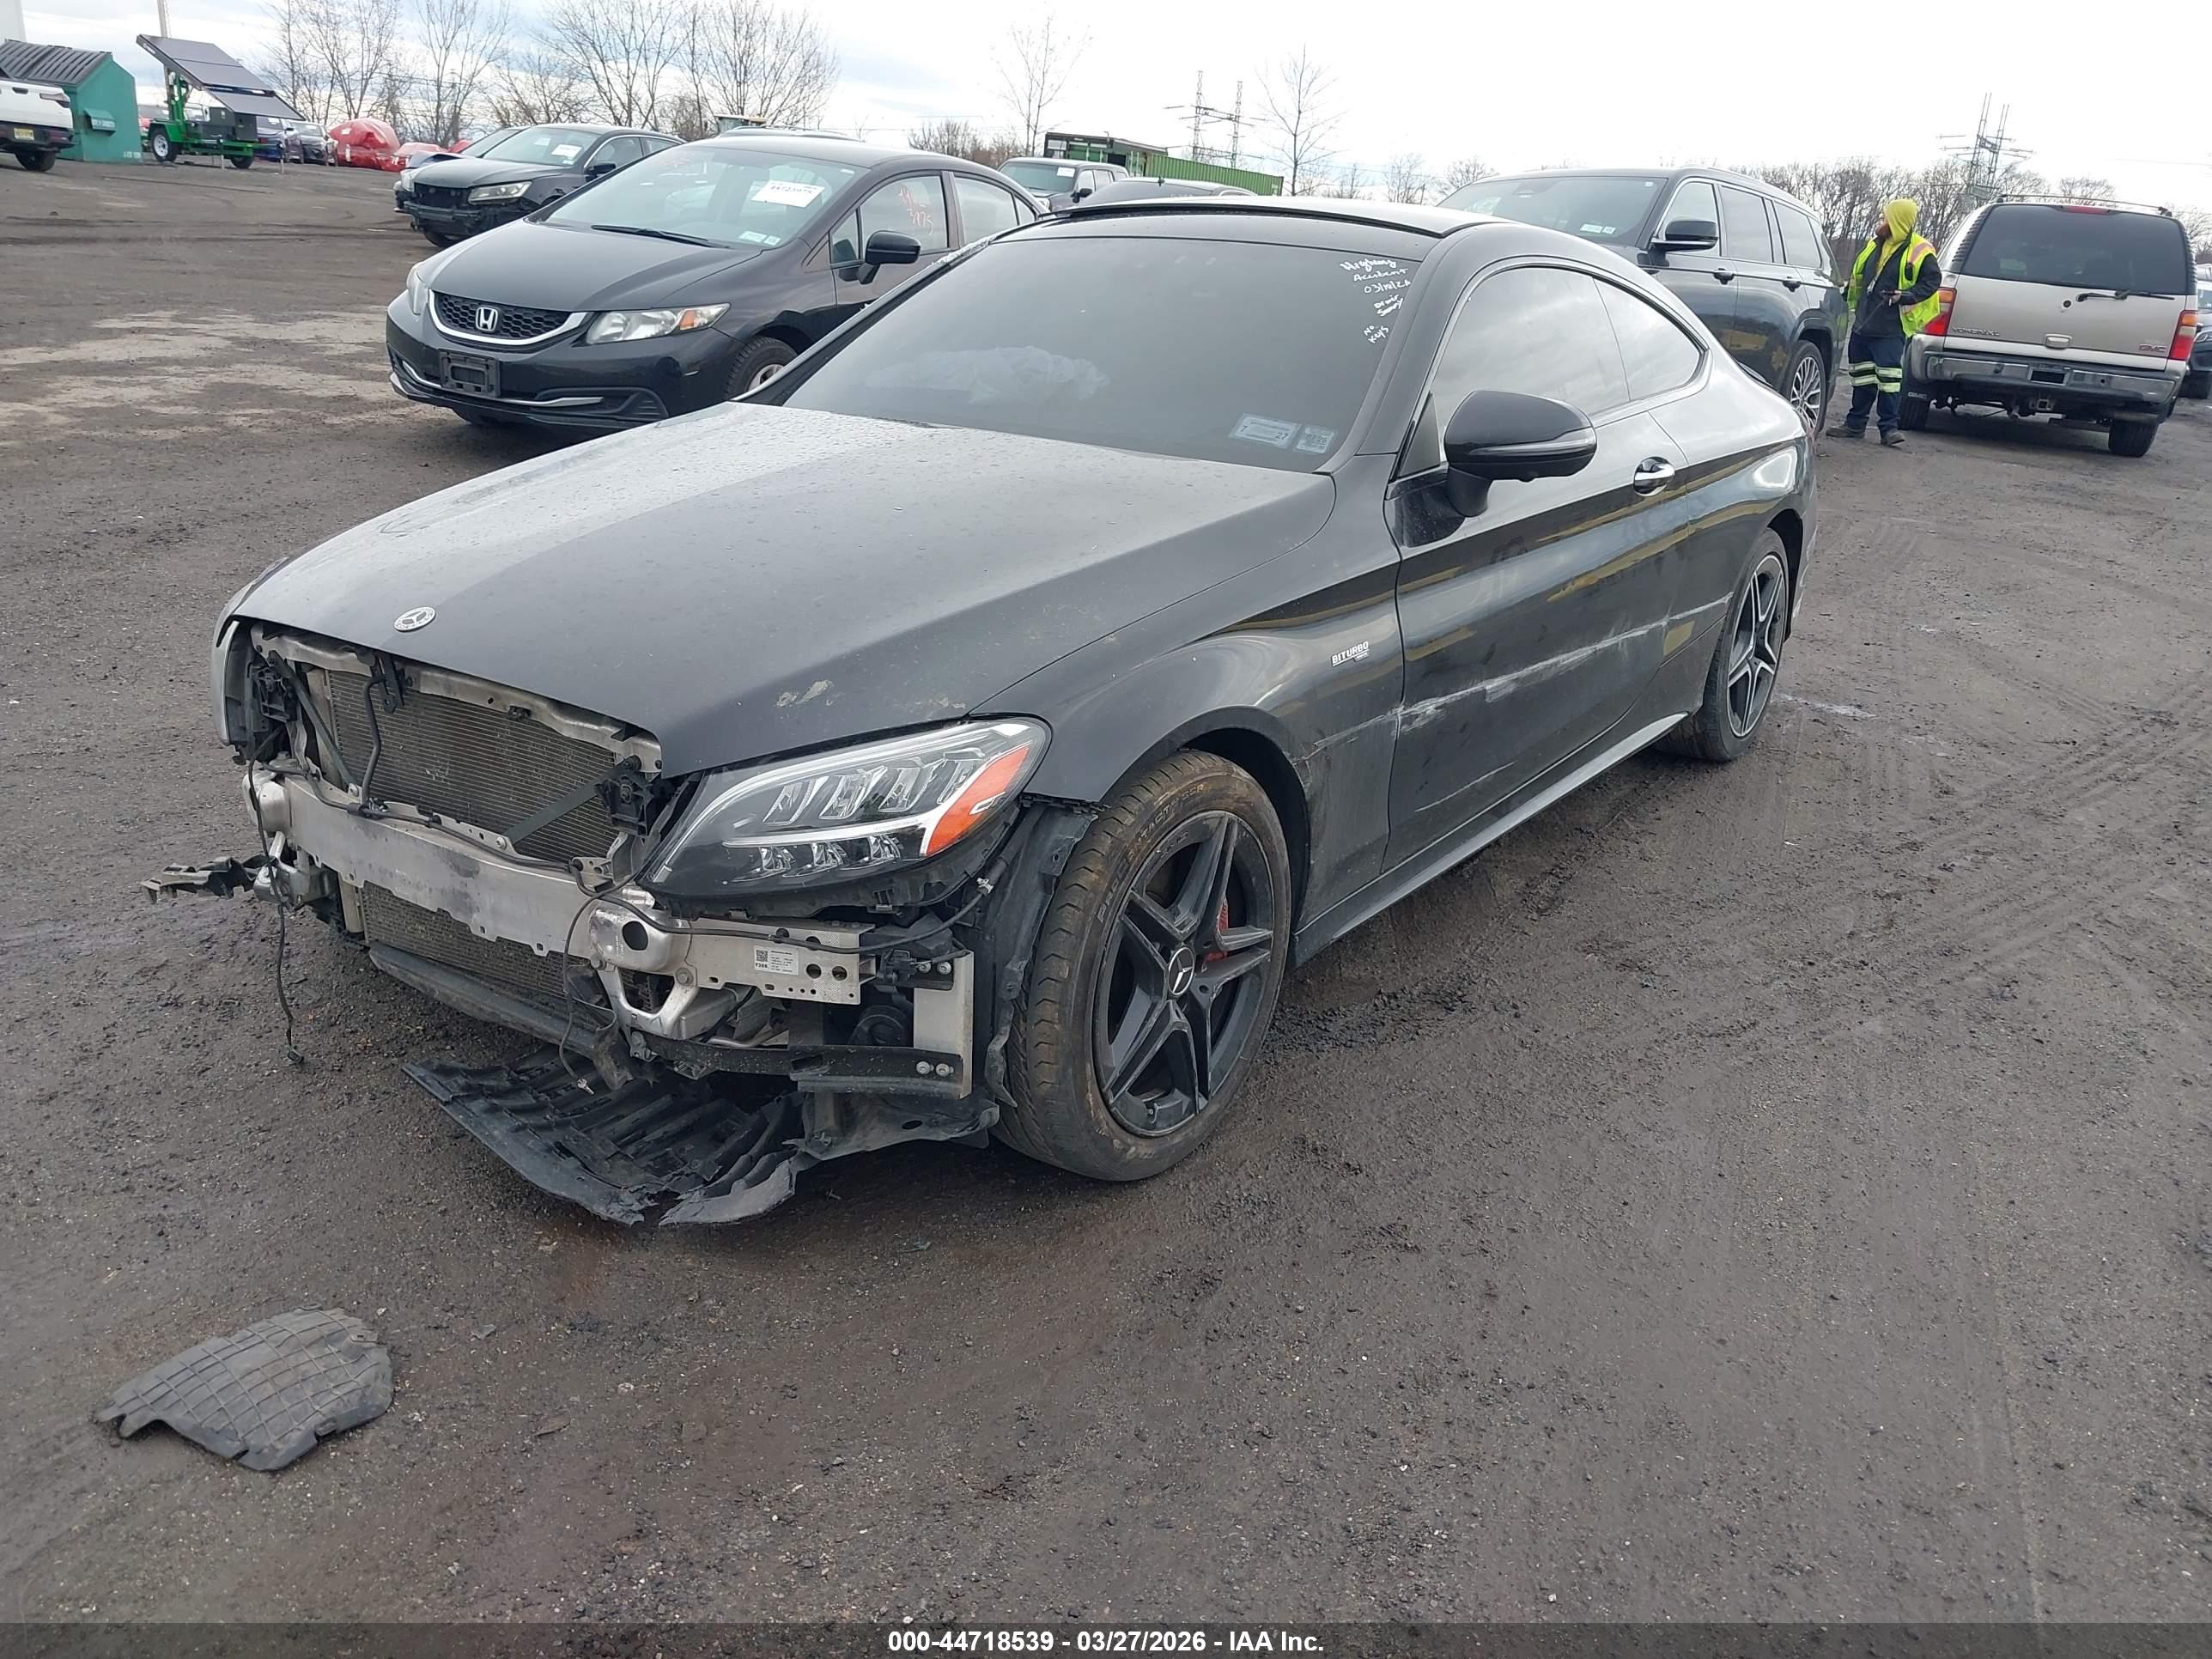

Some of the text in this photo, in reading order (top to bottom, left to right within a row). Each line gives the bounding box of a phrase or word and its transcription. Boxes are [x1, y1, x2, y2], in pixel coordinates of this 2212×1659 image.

[2138, 343, 2167, 352] GMC
[1275, 432, 1289, 441] 27
[1332, 641, 1369, 664] BITURBO
